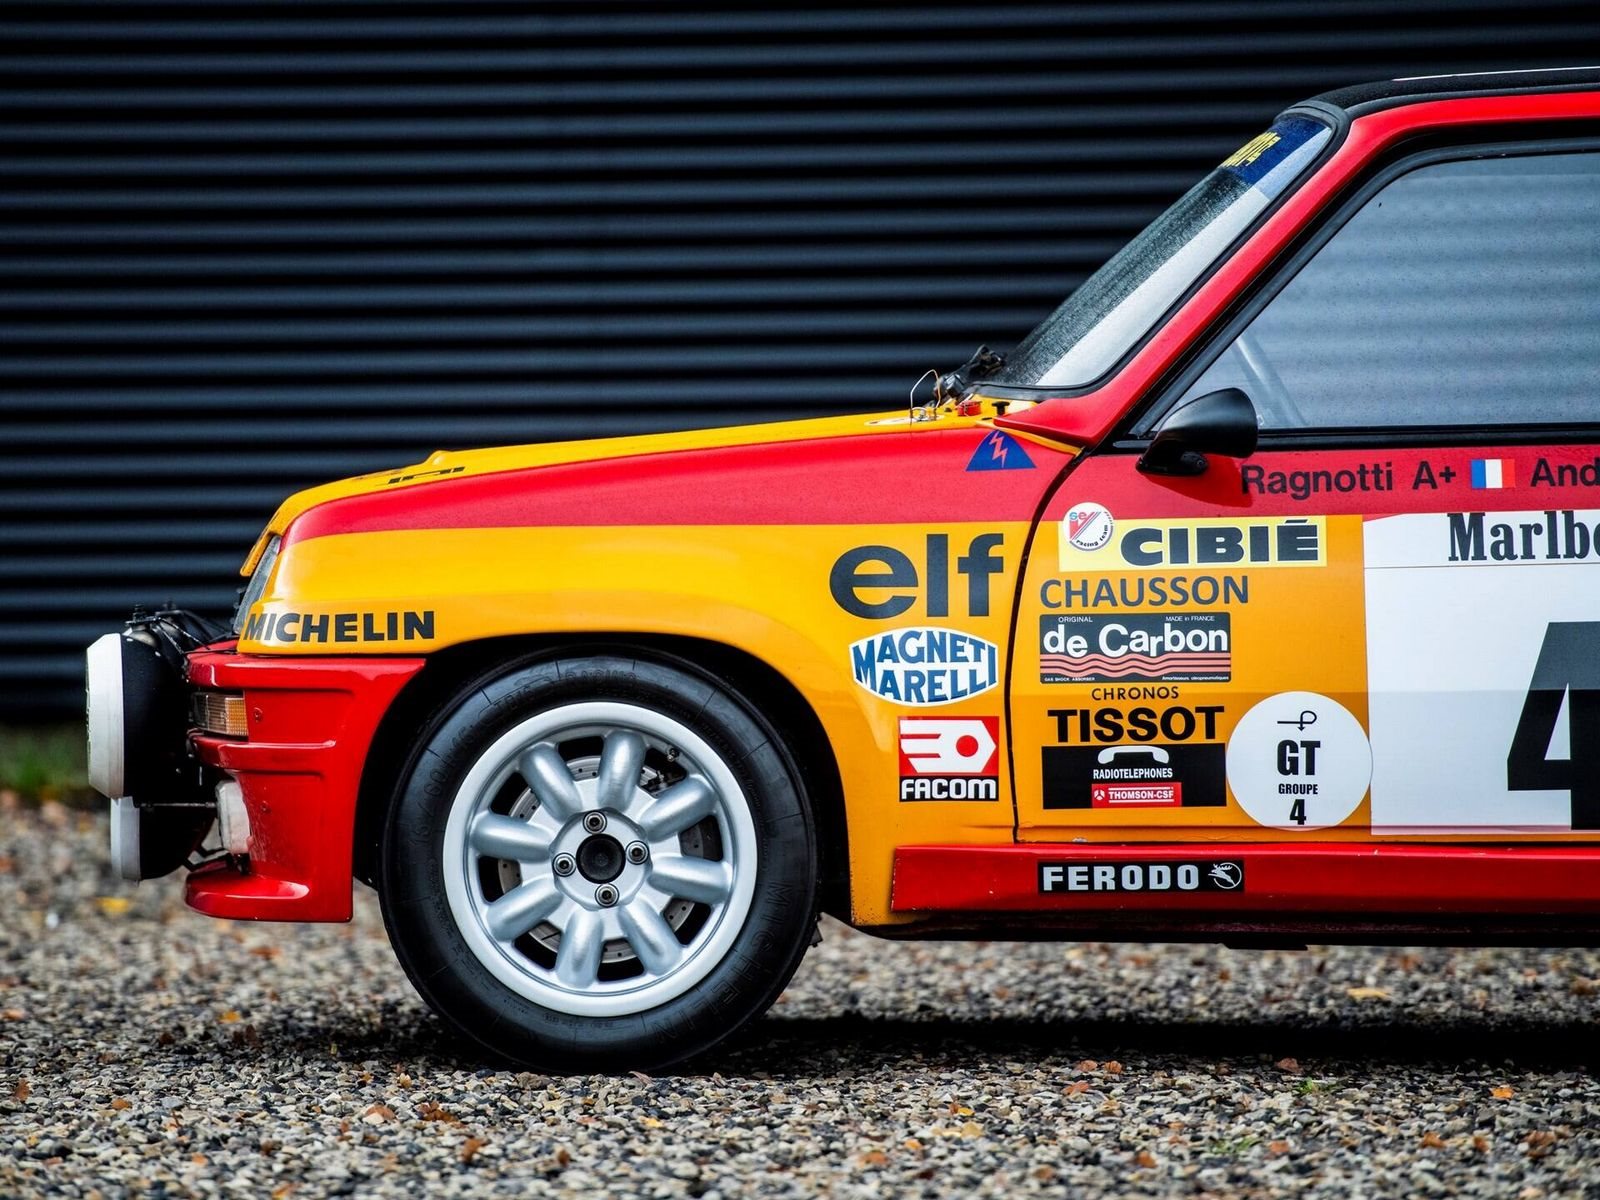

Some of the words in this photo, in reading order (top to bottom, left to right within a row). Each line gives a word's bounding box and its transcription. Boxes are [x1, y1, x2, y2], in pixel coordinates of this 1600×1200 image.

[1241, 461, 1393, 499] Ragnotti
[1412, 460, 1457, 490] A+
[1120, 518, 1319, 566] CIBIÉ
[829, 533, 1004, 619] elf
[1040, 575, 1249, 608] CHAUSSON
[243, 611, 435, 643] MICHELIN
[1043, 624, 1088, 658] de
[1098, 622, 1228, 658] Carbon
[852, 630, 996, 676] MAGNETI
[852, 656, 996, 703] MARELLI
[1091, 685, 1179, 700] CHRONOS
[1047, 706, 1225, 743] TISSOT
[1093, 768, 1173, 779] RADIOTELEPHONES
[1277, 739, 1321, 776] GT
[901, 779, 996, 800] FACOM
[1108, 790, 1174, 800] THOMSON-CSF
[1278, 783, 1318, 794] GROUPE
[1289, 799, 1306, 825] 4
[1043, 864, 1199, 891] FERODO
